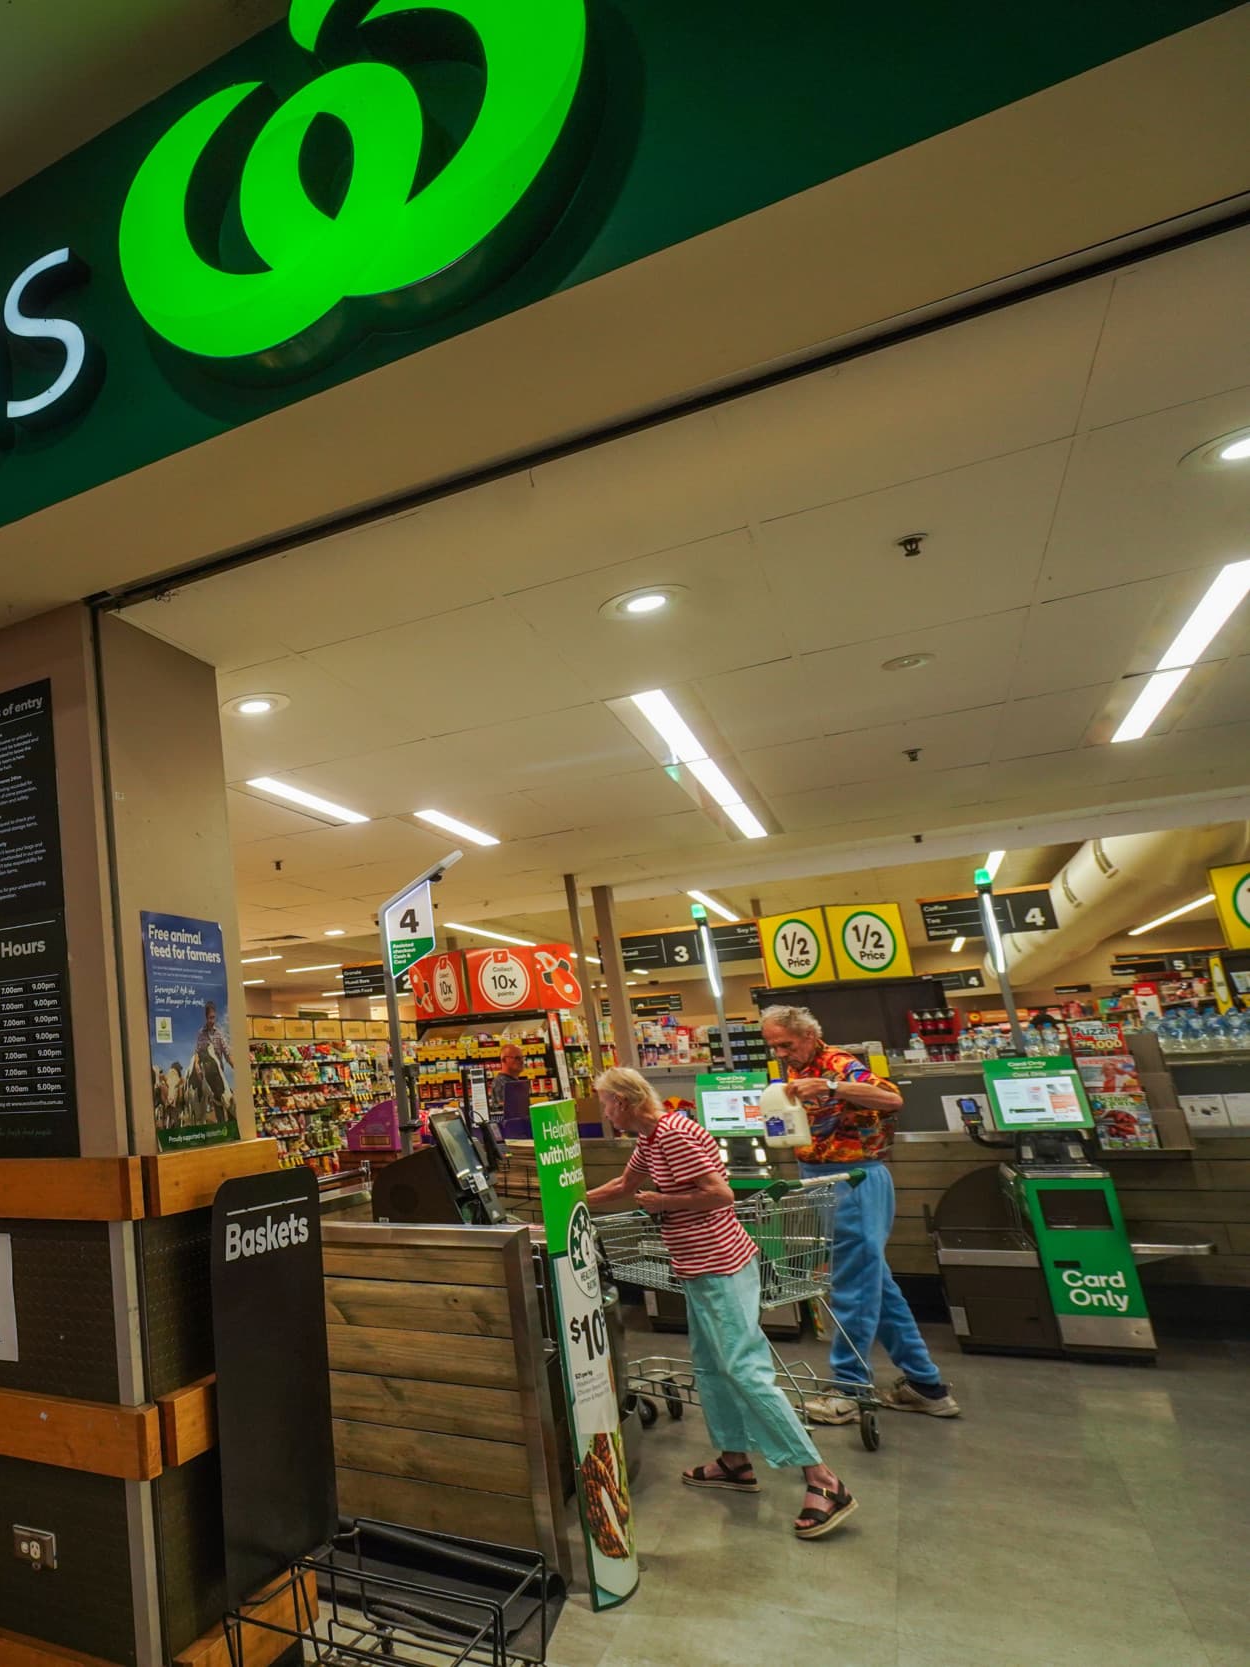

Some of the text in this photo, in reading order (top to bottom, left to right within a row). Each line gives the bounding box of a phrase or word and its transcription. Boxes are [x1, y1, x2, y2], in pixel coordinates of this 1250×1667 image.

[2, 703, 15, 716] of
[14, 697, 43, 713] entry
[400, 908, 419, 934] 4
[1024, 907, 1046, 926] 4
[148, 923, 202, 945] Free animal
[852, 924, 885, 950] 1/2
[1, 940, 46, 958] Hours
[150, 941, 221, 964] feed for farmers
[674, 946, 690, 962] 3
[782, 932, 810, 957] 1/2
[787, 958, 811, 968] Price
[860, 950, 886, 961] Price
[1172, 960, 1186, 970] 5
[439, 980, 453, 996] 10x
[492, 974, 518, 990] 10x
[1072, 1026, 1118, 1036] Puzzle
[539, 1144, 564, 1166] with
[226, 1213, 309, 1262] Baskets
[1062, 1270, 1126, 1289] Card
[1069, 1288, 1129, 1312] Only
